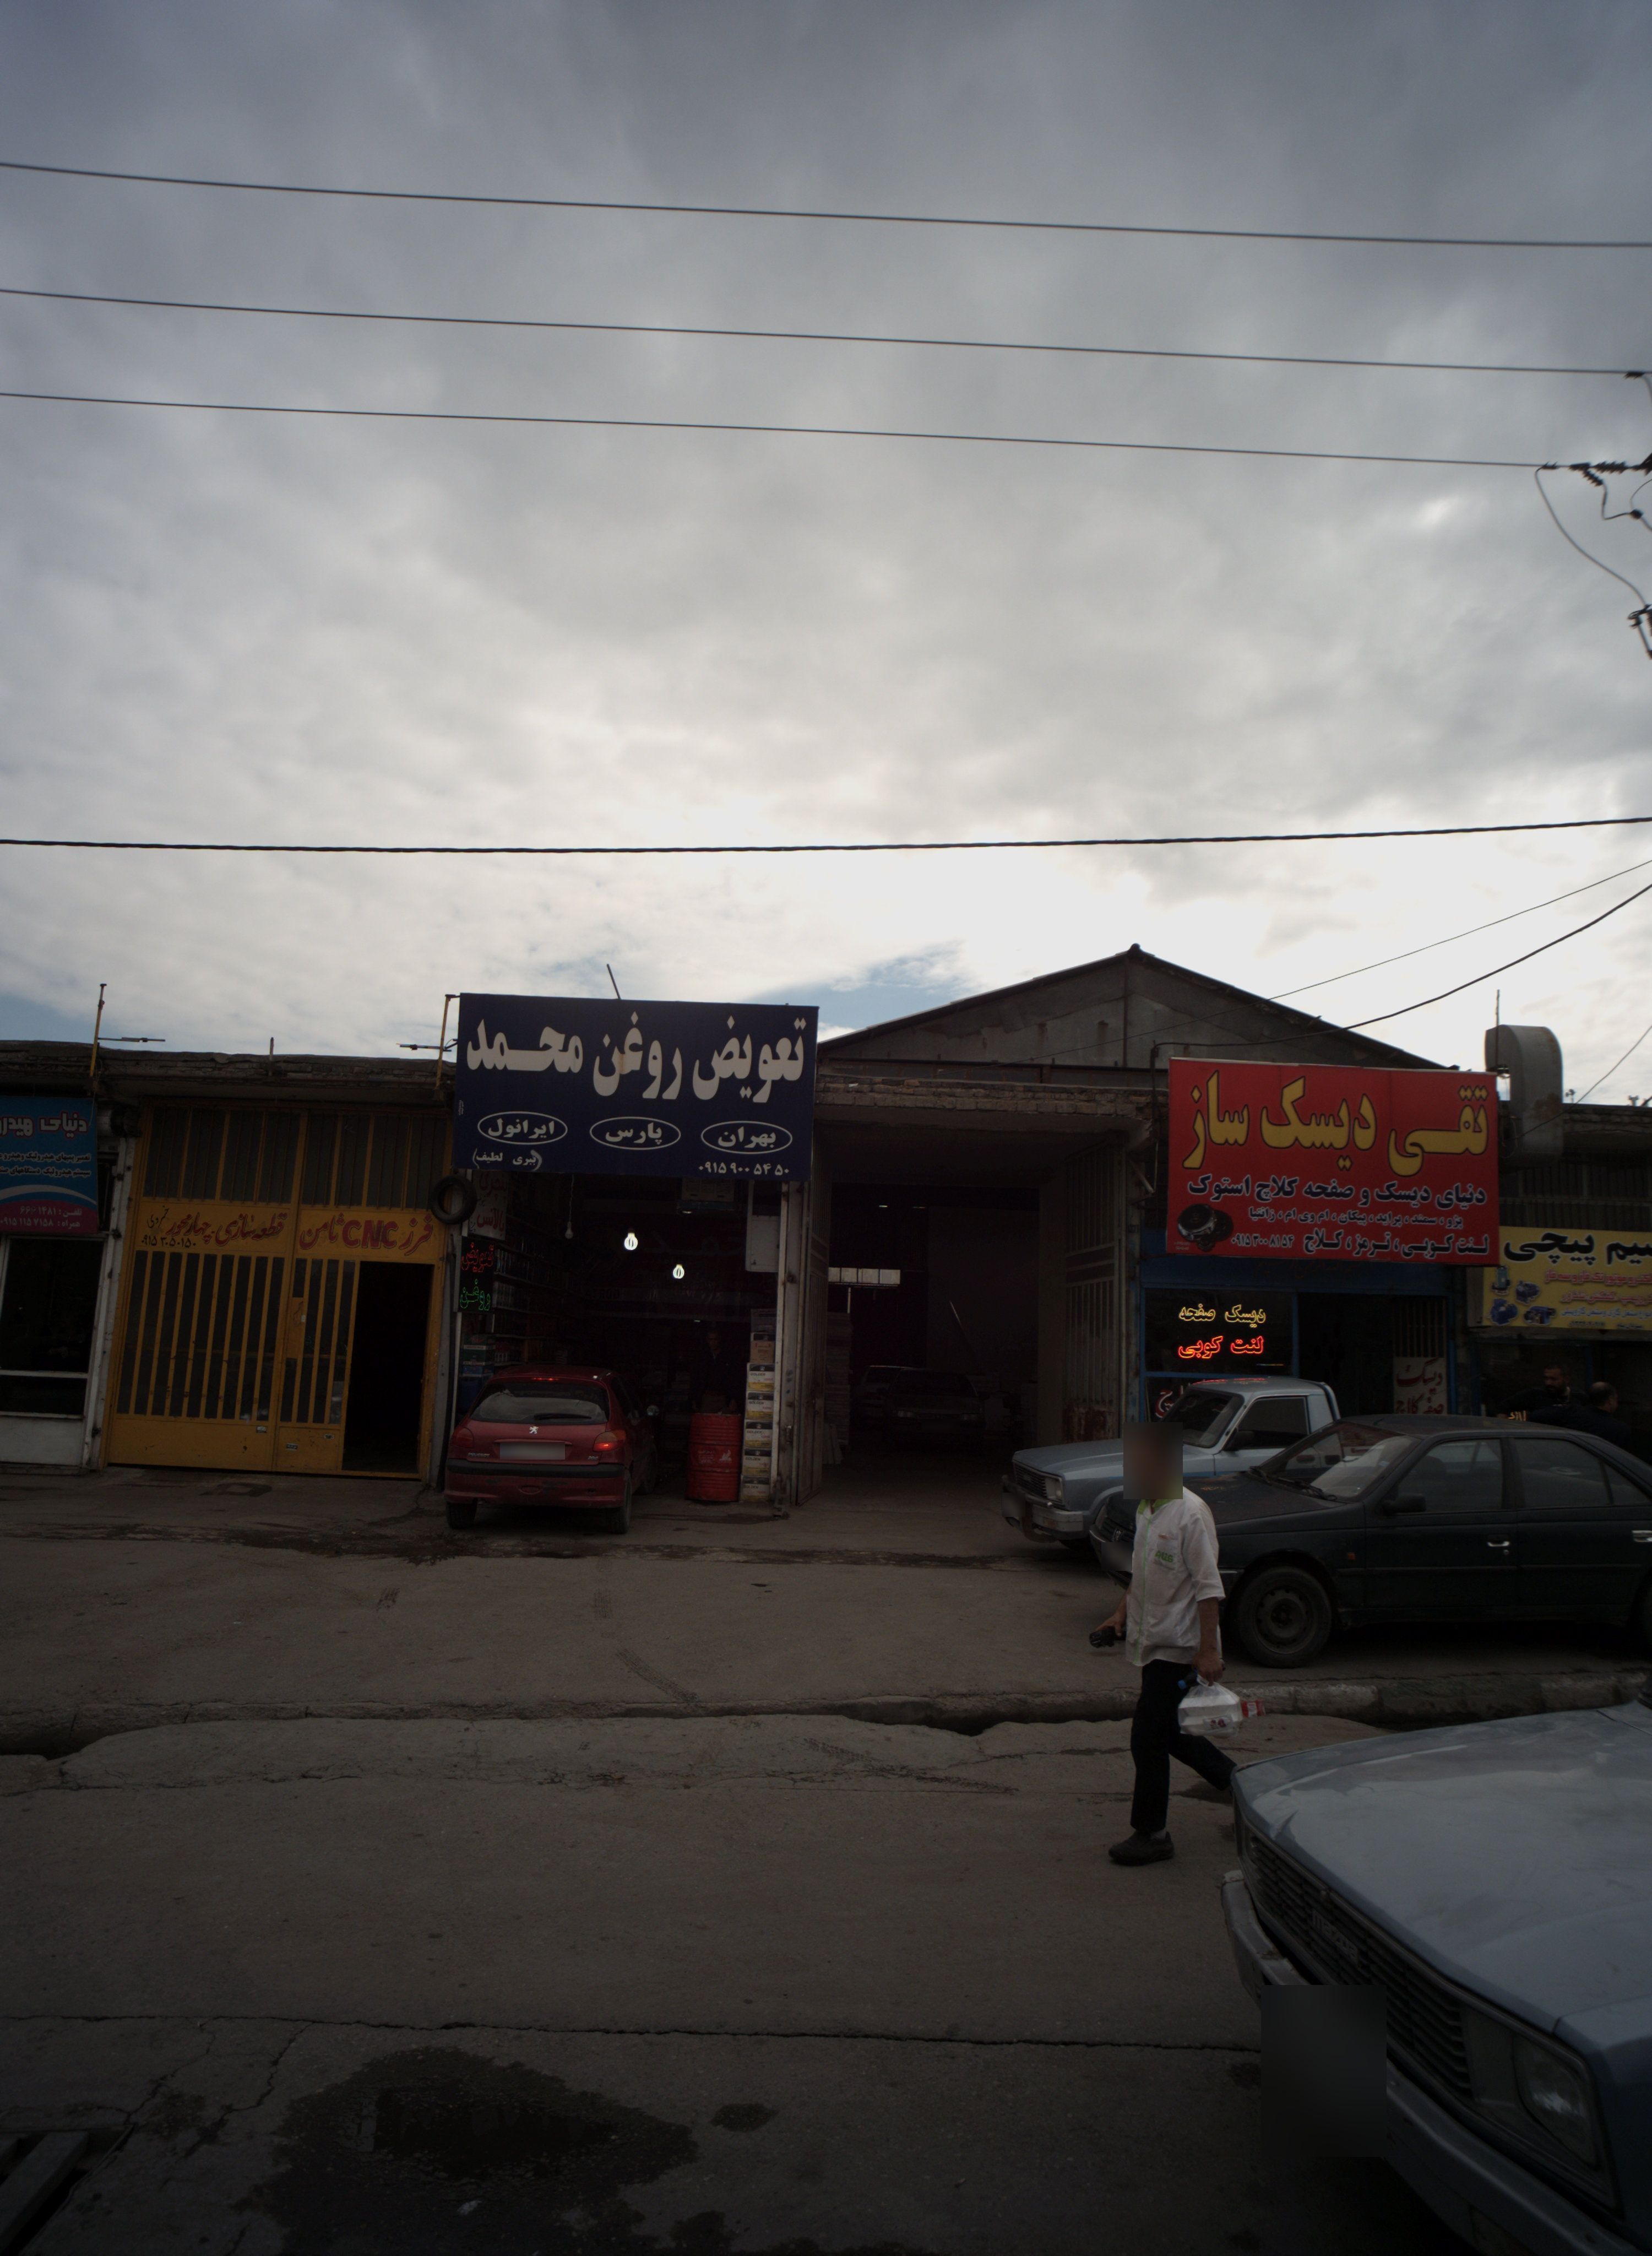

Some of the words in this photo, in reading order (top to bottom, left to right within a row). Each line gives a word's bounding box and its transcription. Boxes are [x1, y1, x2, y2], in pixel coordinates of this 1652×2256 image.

[466, 1018, 583, 1074] محمد
[593, 1010, 682, 1100] روغن
[692, 1015, 807, 1103] تعویض
[0, 1116, 33, 1137] هیدر
[41, 1113, 88, 1138] دنیای
[487, 1117, 556, 1139] ایرانول
[1182, 1070, 1249, 1169] ساز
[1260, 1075, 1377, 1172] دیسک
[1388, 1085, 1488, 1178] تقی
[605, 1122, 663, 1145] پارس
[718, 1126, 776, 1148] بهران
[698, 1160, 727, 1174] ۰۹۱۵
[730, 1162, 750, 1174] ۹۰۰
[753, 1163, 771, 1175] ۵۴
[774, 1164, 789, 1176] ۵۰
[1188, 1173, 1251, 1202] استوک
[1255, 1175, 1299, 1202] کلاچ
[1303, 1179, 1355, 1200] صفحه
[1358, 1187, 1371, 1207] و
[1375, 1180, 1432, 1208] دیسک
[1436, 1183, 1486, 1210] دنیای
[166, 1213, 193, 1237] محور
[251, 1212, 287, 1240] قطعه
[1248, 1206, 1276, 1222] زانتیا
[1298, 1211, 1316, 1223] وی
[1317, 1209, 1330, 1223] ام
[142, 1234, 157, 1246] ۰۹۱۵
[299, 1212, 345, 1250] ثامن
[342, 1219, 399, 1249] CNC
[399, 1212, 433, 1256] فرز
[1231, 1233, 1252, 1247] ۰۹۱۵
[1457, 1234, 1489, 1254] لنت
[1503, 1232, 1596, 1266] پیچی
[461, 1241, 494, 1273] تعویض
[459, 1278, 492, 1311] روغن
[1178, 1303, 1216, 1321] صفحه
[1224, 1304, 1266, 1328] دیسک
[1177, 1335, 1224, 1359] کوبی
[1230, 1335, 1265, 1354] لنت
